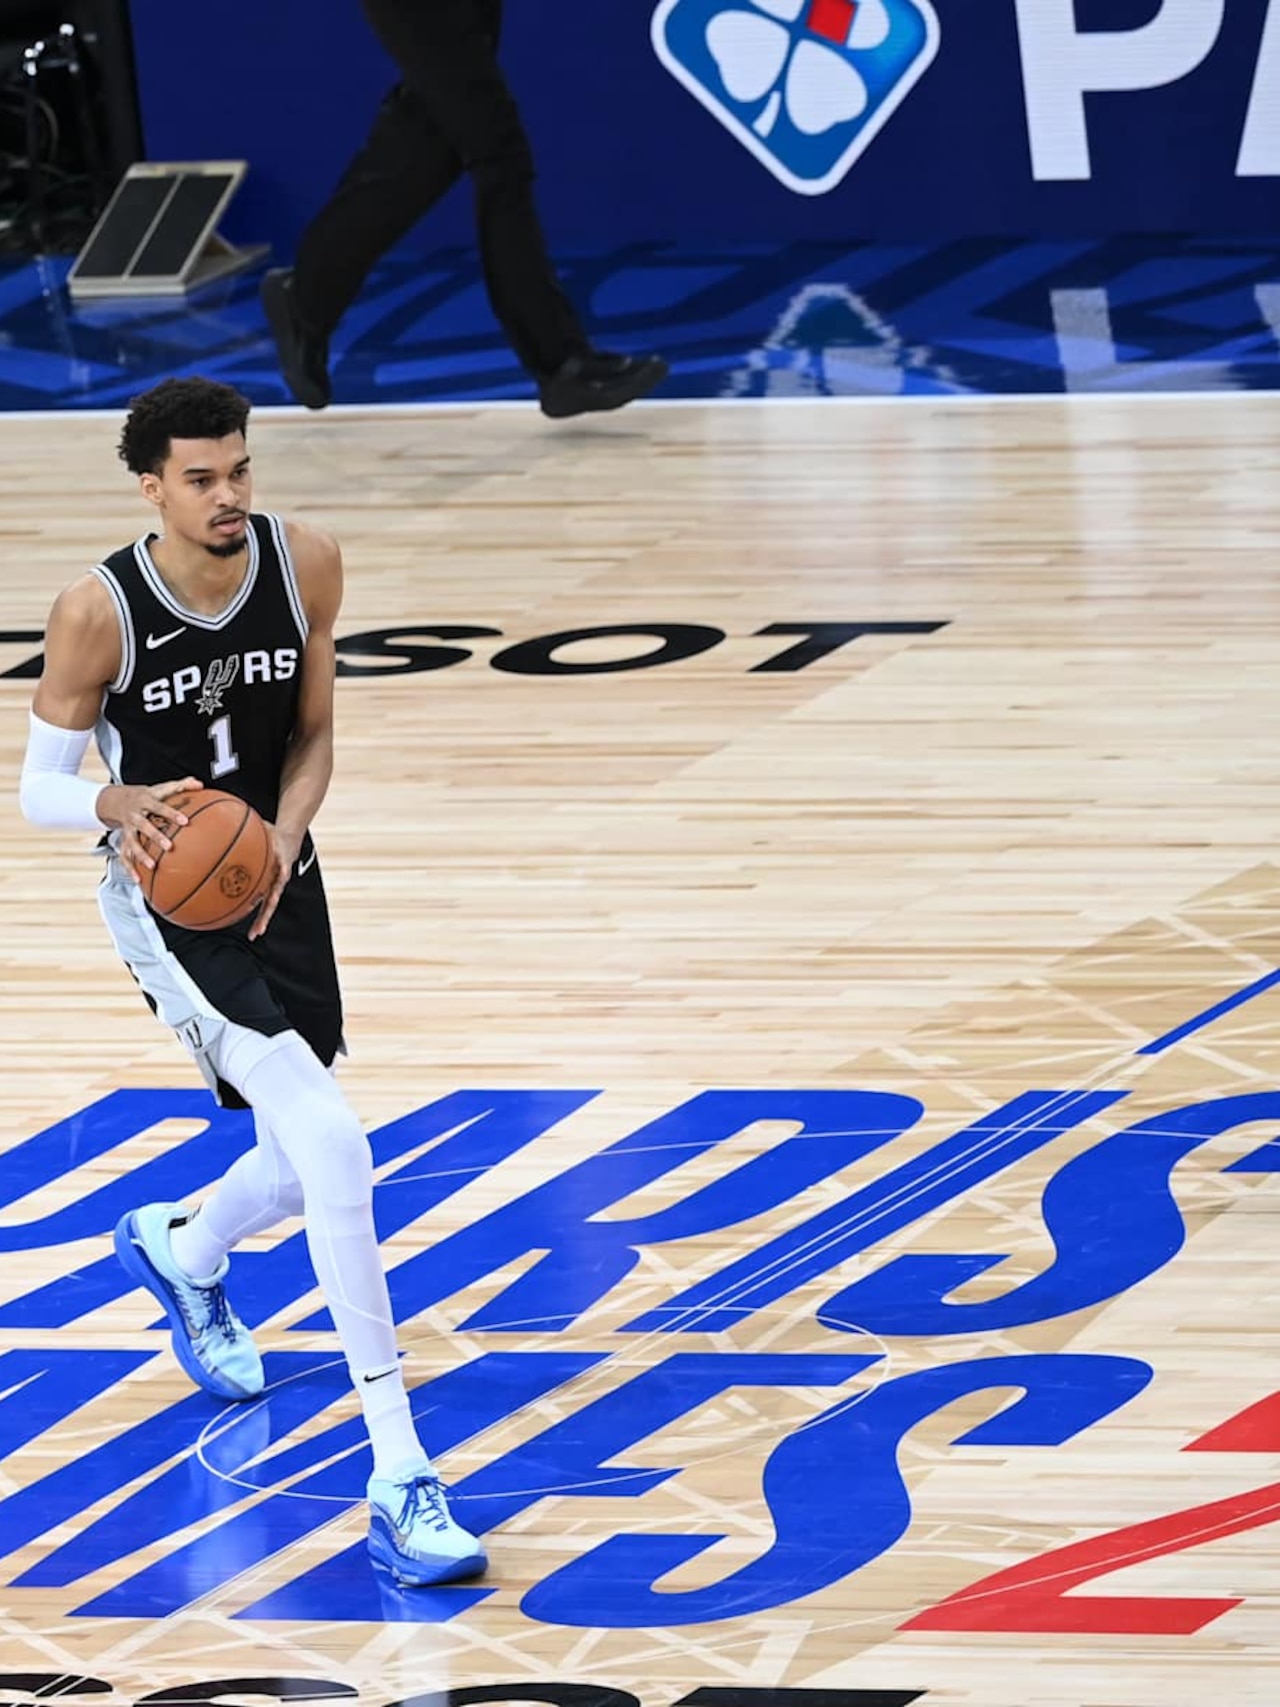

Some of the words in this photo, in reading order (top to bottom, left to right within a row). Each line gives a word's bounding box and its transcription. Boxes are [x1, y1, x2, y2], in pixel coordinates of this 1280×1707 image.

[1014, 0, 1280, 181] P
[142, 648, 299, 714] SPURS
[207, 714, 240, 780] 1
